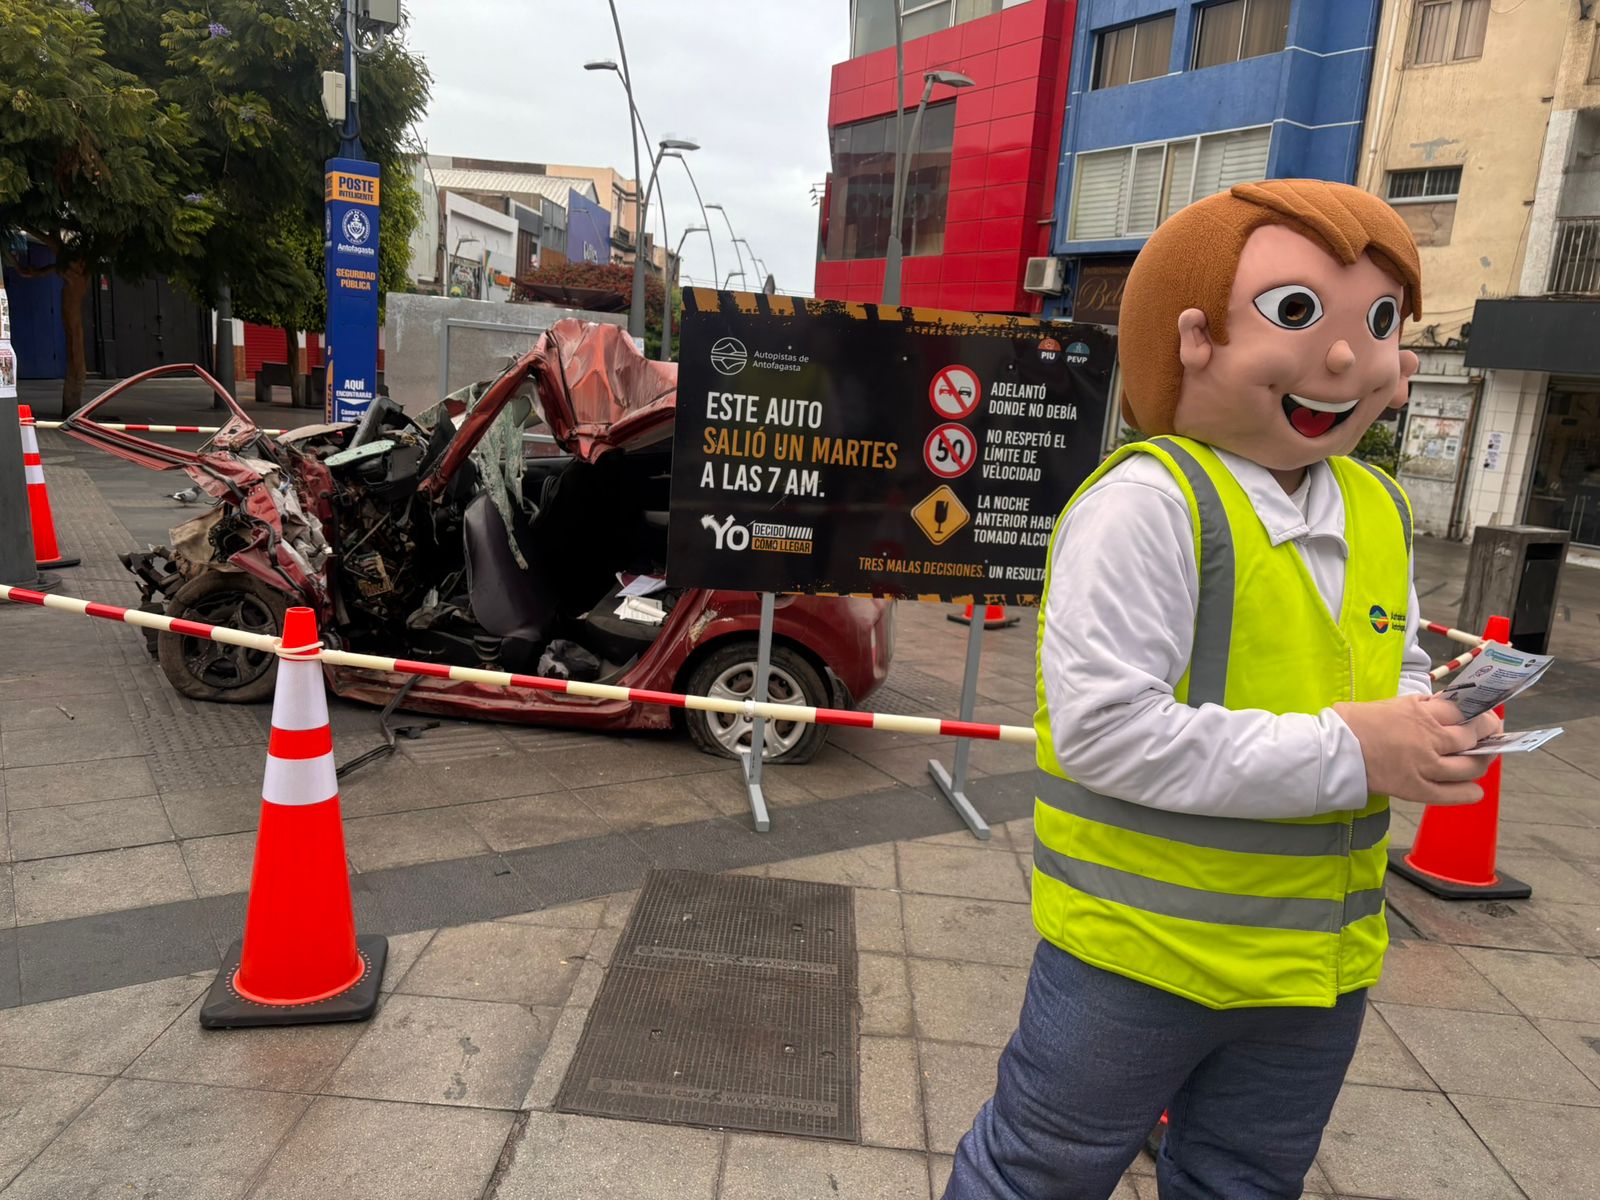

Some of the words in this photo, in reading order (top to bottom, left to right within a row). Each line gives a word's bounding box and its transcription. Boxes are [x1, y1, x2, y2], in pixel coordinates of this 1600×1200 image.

[338, 176, 375, 194] POSTE
[337, 243, 375, 256] Antofagasta
[335, 267, 376, 281] SEGURIDAD
[753, 350, 797, 363] Autopistas
[798, 354, 810, 363] de
[1040, 350, 1056, 361] PIU
[1066, 355, 1088, 365] PEVP
[752, 360, 801, 373] Antofagasta
[344, 378, 365, 391] AQUÍ
[990, 381, 1047, 401] ADELANTÓ
[706, 391, 760, 423] ESTE
[764, 397, 823, 429] AUTO
[988, 399, 1026, 418] DONDE
[1028, 404, 1044, 419] NO
[1046, 403, 1078, 422] DEBÍA
[702, 426, 767, 460] SALIÓ
[773, 432, 805, 463] UN
[811, 436, 899, 471] MARTES
[986, 429, 1002, 445] NO
[1004, 430, 1052, 450] RESPETÓ
[1053, 434, 1067, 450] EL
[983, 447, 1020, 464] LÍMITE
[1022, 450, 1038, 465] DE
[699, 461, 715, 489] A
[721, 463, 763, 494] LAS
[766, 466, 782, 494] 7
[784, 468, 826, 498] AM.
[982, 464, 1042, 483] VELOCIDAD
[977, 494, 992, 511] LA
[993, 496, 1031, 513] NOCHE
[754, 524, 784, 537] DECIDO
[974, 512, 1028, 530] ANTERIOR
[1029, 513, 1057, 531] HABÍ
[779, 540, 810, 553] LLEGAR
[973, 528, 1018, 546] TOMADO
[1019, 532, 1050, 548] ALCO
[858, 556, 885, 573] TRES
[886, 559, 922, 575] MALAS
[923, 561, 987, 579] DECISIONES.
[988, 565, 1004, 579] UN
[1005, 566, 1048, 582] RESULTA
